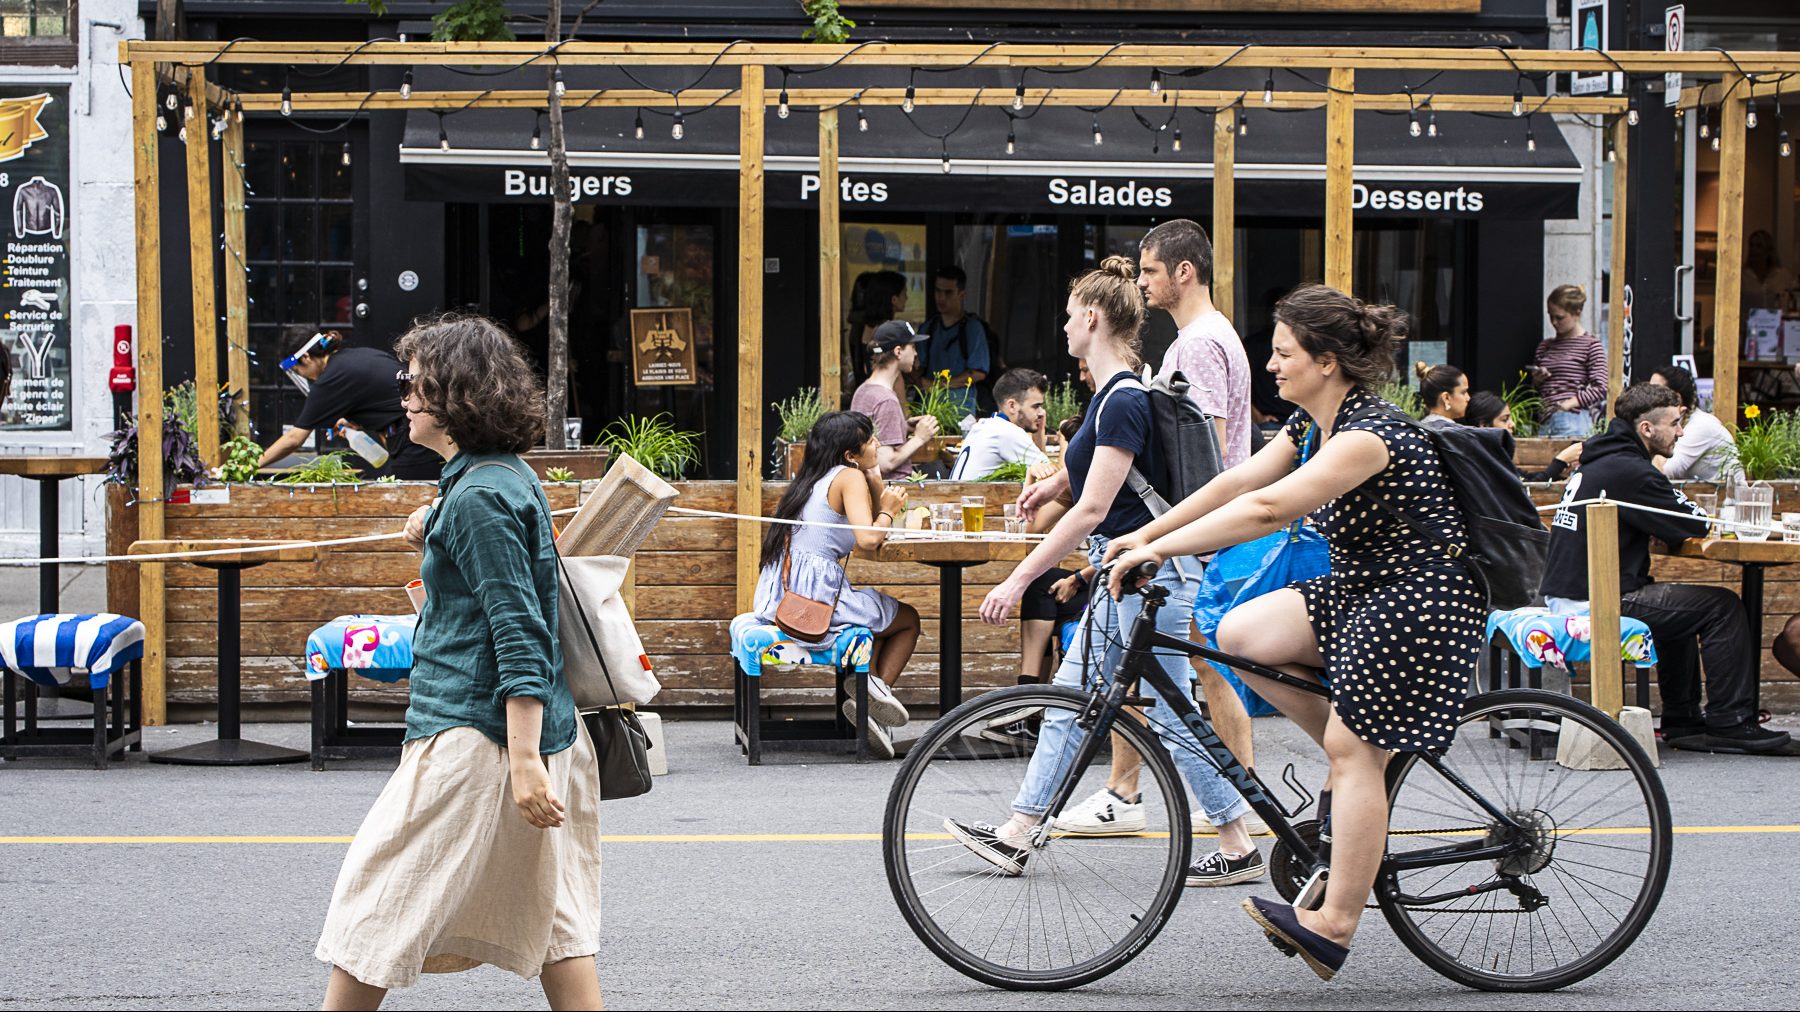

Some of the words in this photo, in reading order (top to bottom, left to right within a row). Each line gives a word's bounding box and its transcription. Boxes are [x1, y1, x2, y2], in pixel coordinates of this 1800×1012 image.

[505, 170, 632, 202] Bugers
[801, 175, 888, 202] Ptes
[1048, 178, 1172, 207] Salades
[1352, 183, 1483, 211] Desserts
[7, 242, 63, 254] Réparation
[7, 254, 55, 264] Doublure
[7, 265, 49, 276] Teinture
[7, 277, 62, 287] Traitement
[9, 310, 48, 320] Service
[49, 310, 63, 320] de
[9, 321, 55, 332] Serrurier
[51, 377, 64, 388] de
[20, 390, 49, 401] genre
[51, 389, 64, 399] de
[36, 400, 64, 411] éclair
[1184, 712, 1272, 804] GIANT
